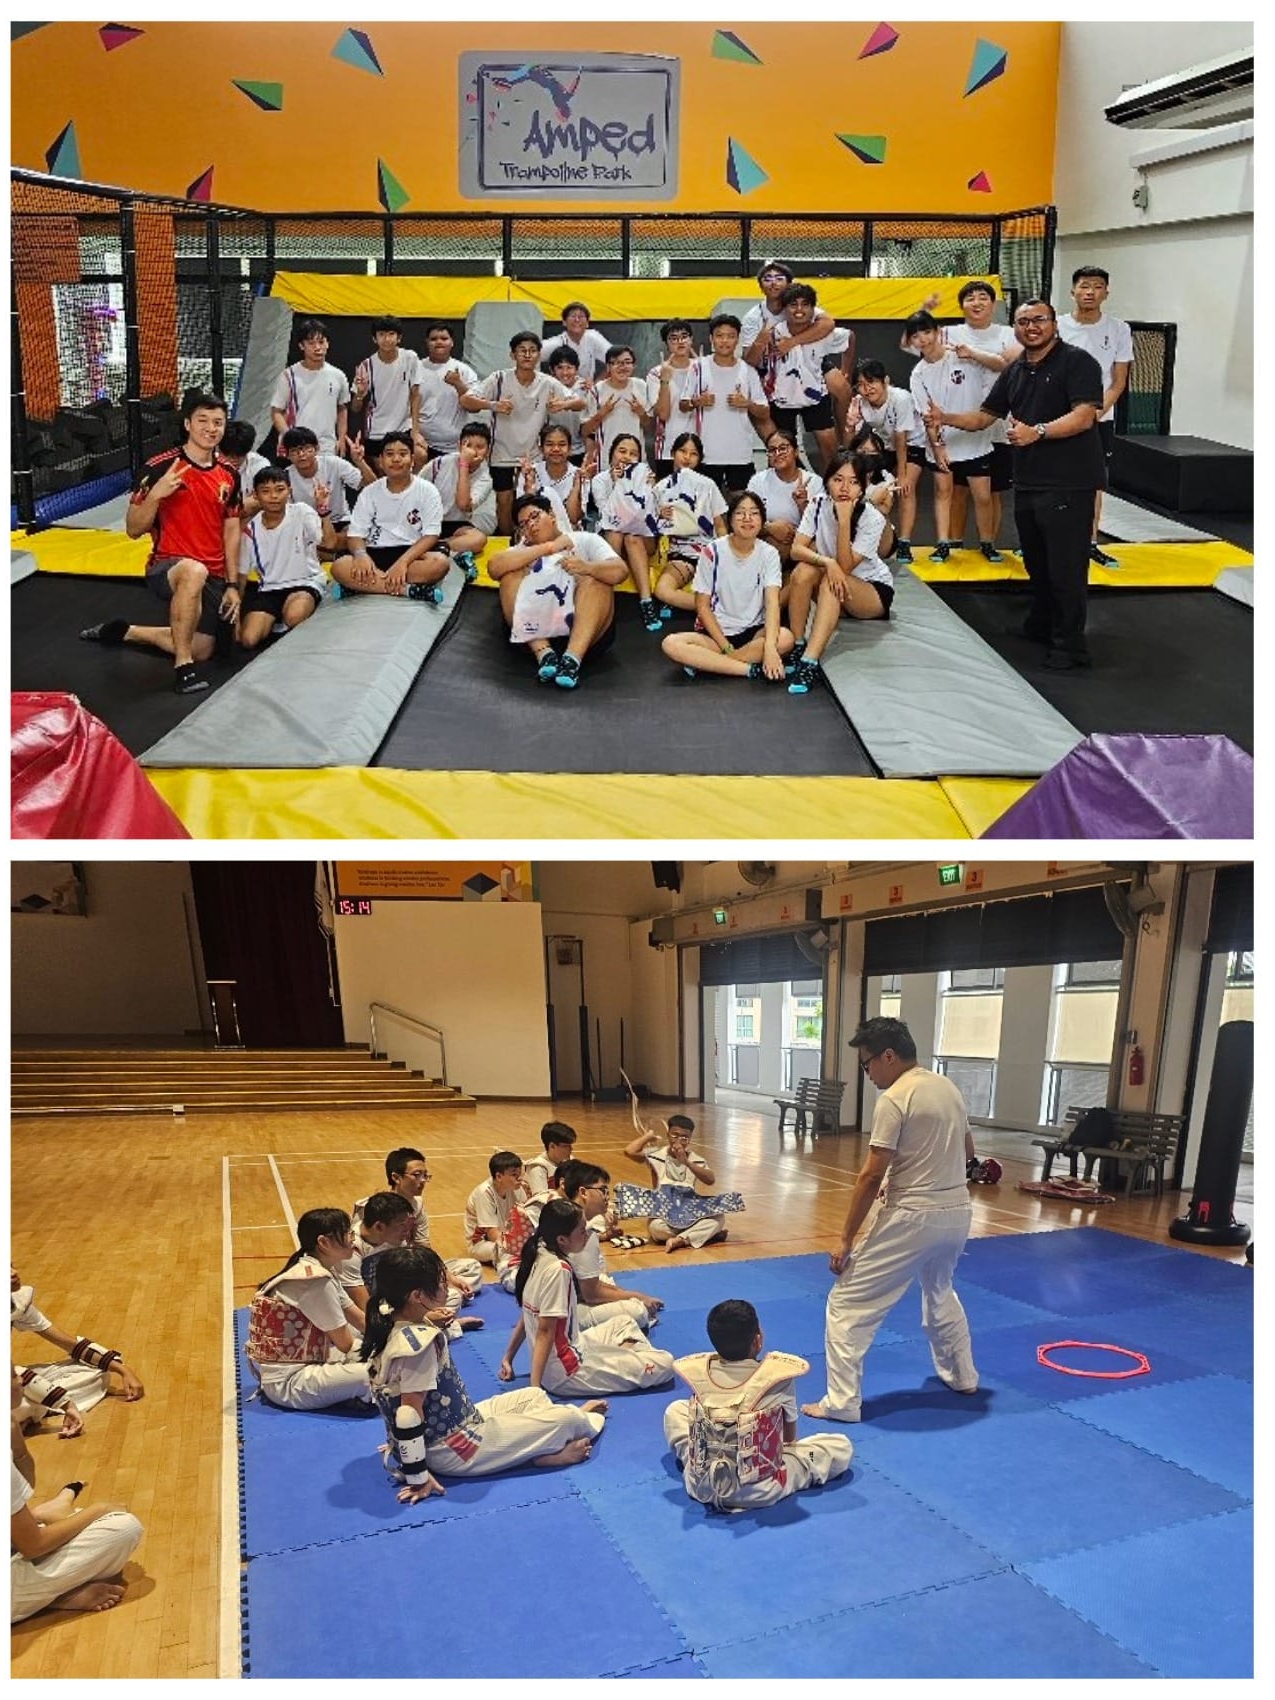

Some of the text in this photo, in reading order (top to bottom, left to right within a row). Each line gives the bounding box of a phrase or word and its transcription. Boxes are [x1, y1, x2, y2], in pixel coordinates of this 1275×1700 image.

[523, 109, 656, 161] Amped
[499, 161, 632, 183] Trampoline Park
[339, 900, 371, 915] 15:14
